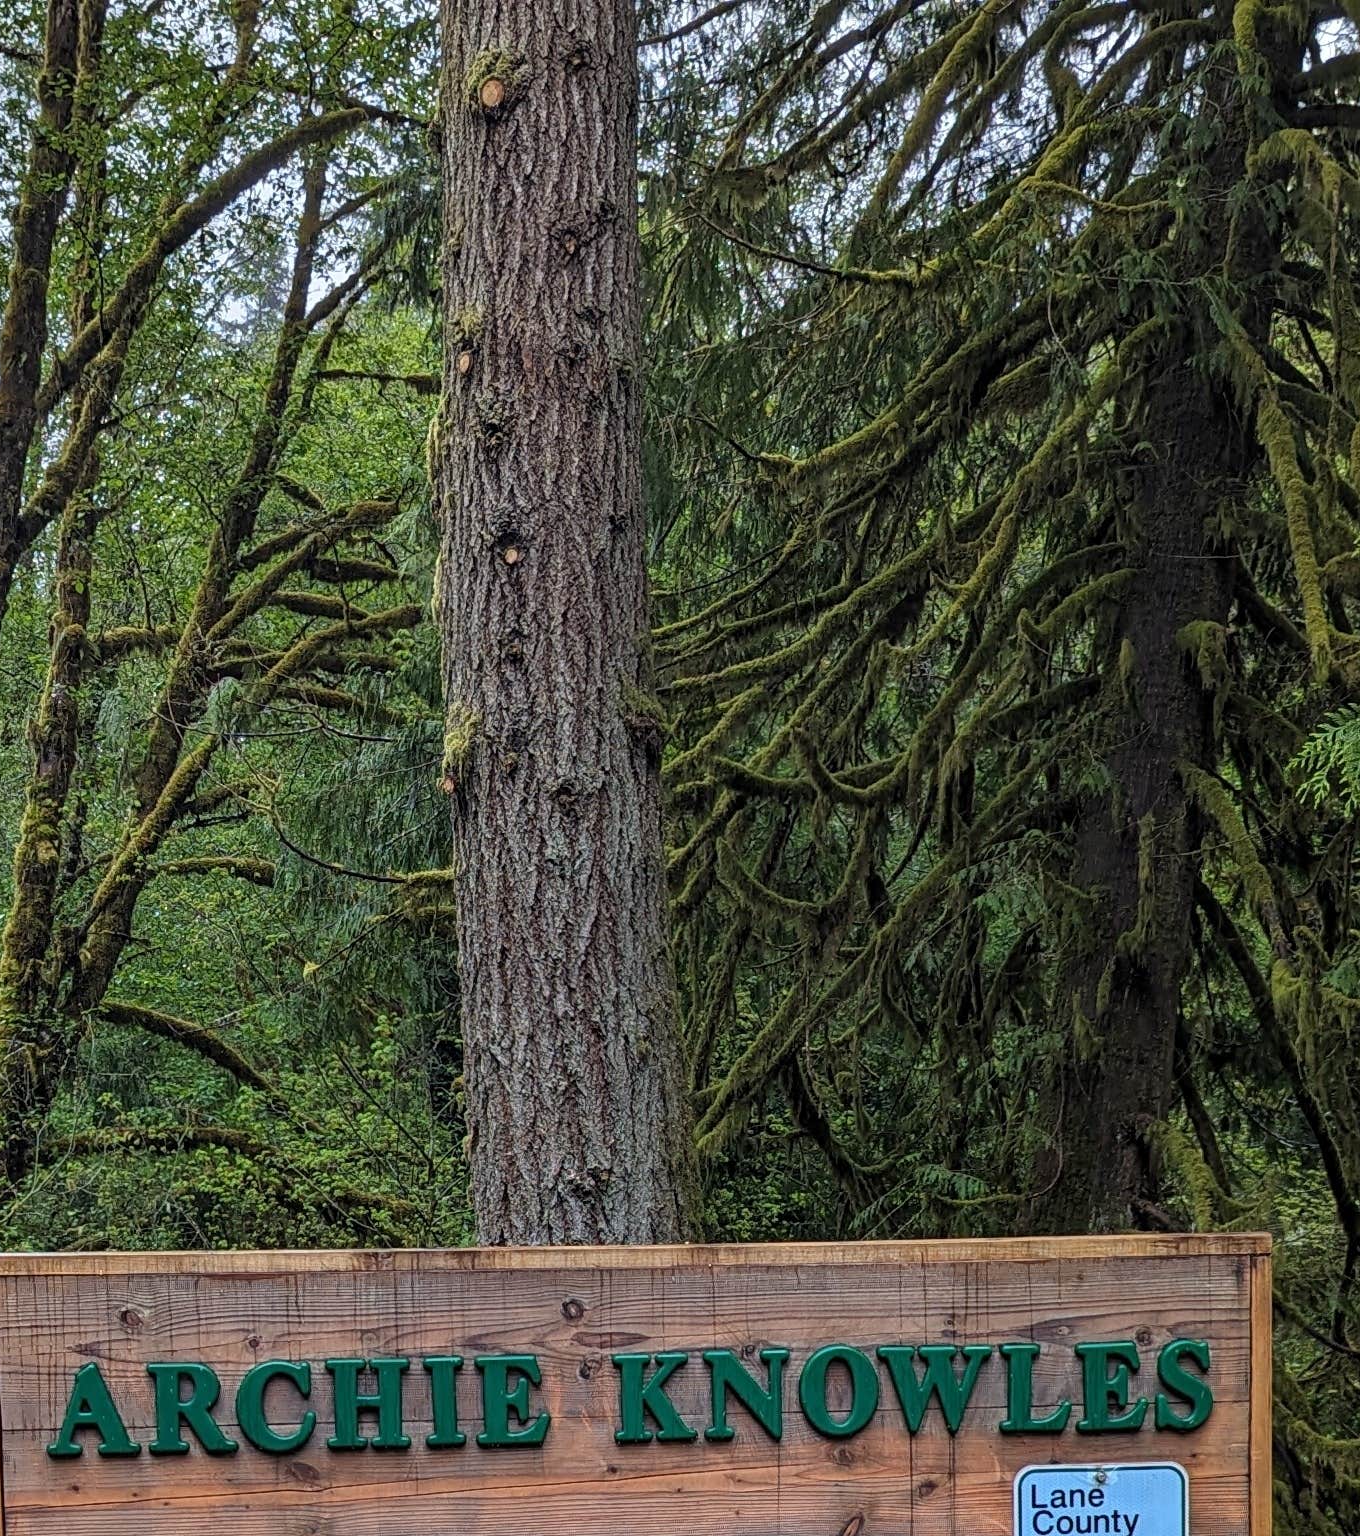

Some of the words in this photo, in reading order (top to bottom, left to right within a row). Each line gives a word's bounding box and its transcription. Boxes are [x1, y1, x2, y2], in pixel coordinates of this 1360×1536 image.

[46, 1354, 551, 1458] ARCHIE
[611, 1338, 1215, 1443] KNOWLES
[1031, 1484, 1104, 1508] Lane
